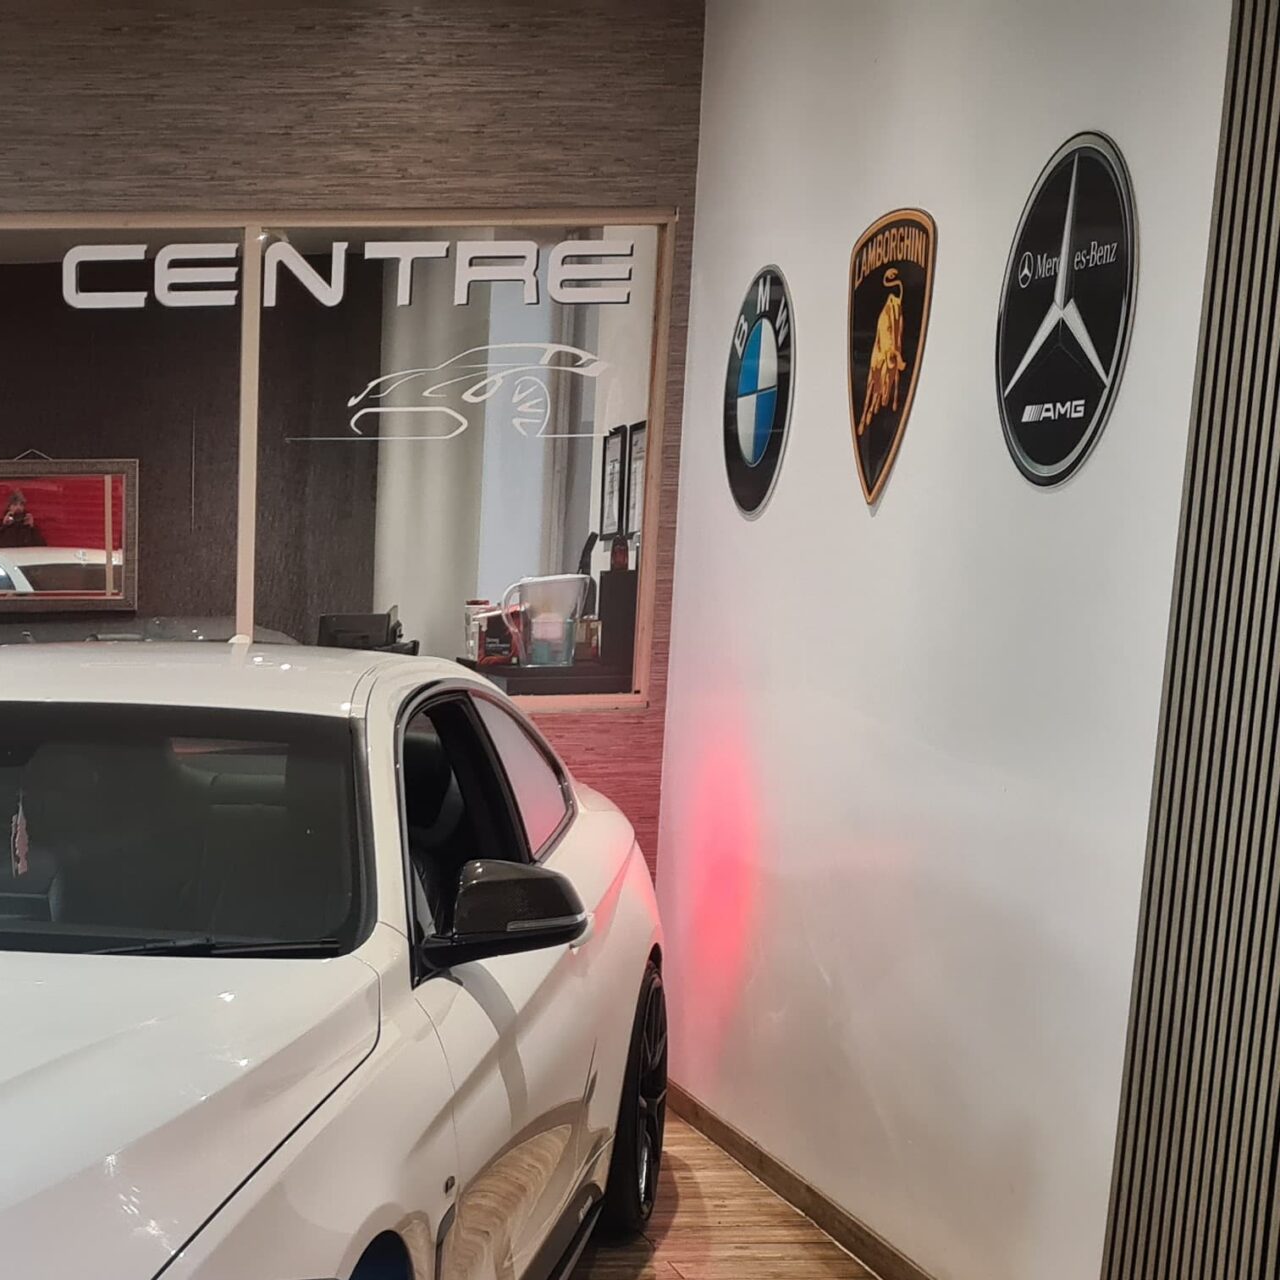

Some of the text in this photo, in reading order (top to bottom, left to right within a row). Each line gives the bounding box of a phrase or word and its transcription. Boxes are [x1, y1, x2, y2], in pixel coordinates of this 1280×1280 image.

[61, 239, 635, 309] CENTRE
[854, 226, 926, 290] LAMBORGHINI
[1034, 240, 1118, 280] Merces-Benz
[733, 274, 789, 360] BMW
[1040, 399, 1086, 421] AMG
